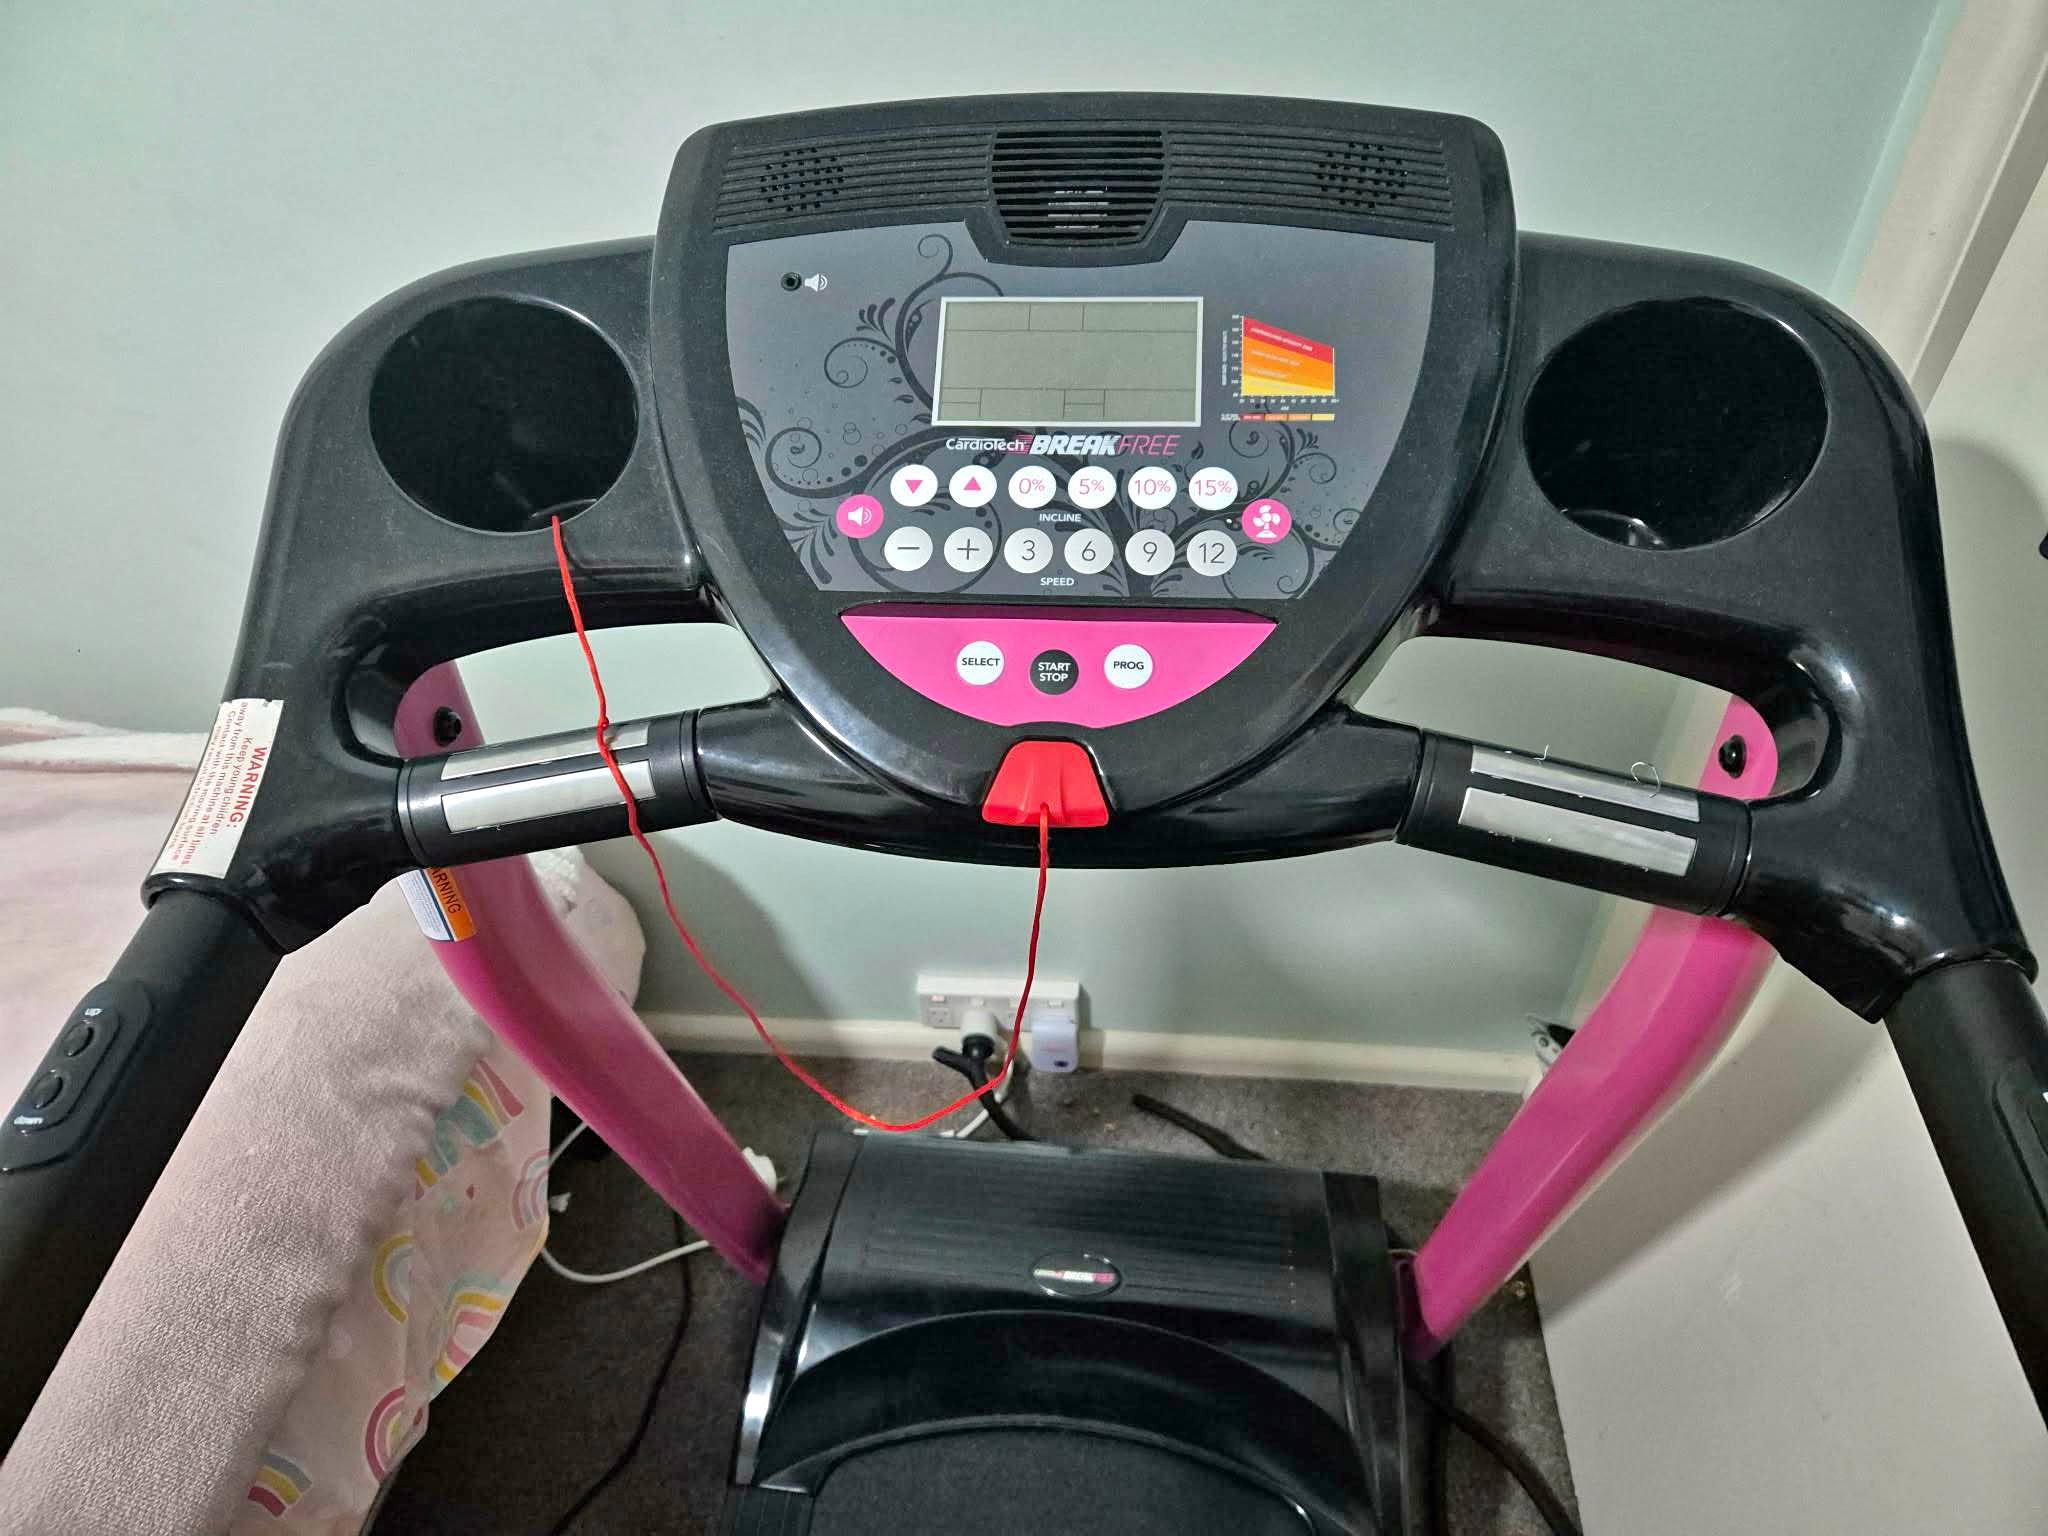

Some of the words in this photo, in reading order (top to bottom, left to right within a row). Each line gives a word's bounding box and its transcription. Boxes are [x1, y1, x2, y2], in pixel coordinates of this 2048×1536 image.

[1018, 477, 1046, 495] 0%
[1078, 478, 1105, 495] 5%
[1134, 479, 1171, 496] 10%
[1195, 479, 1232, 497] 15%
[1039, 513, 1082, 523] INCLINE
[1021, 540, 1036, 561] 3
[1081, 540, 1097, 562] 6
[1143, 541, 1158, 563] 9
[1199, 542, 1226, 564] 12
[1040, 576, 1075, 588] SPEED
[961, 657, 1000, 667] SELECT
[1037, 661, 1071, 672] START
[1113, 660, 1145, 670] PROG
[1039, 672, 1069, 683] STOP
[234, 737, 253, 761] Keep
[223, 764, 242, 793] young
[225, 747, 267, 827] WARNING:
[431, 868, 462, 914] RNING
